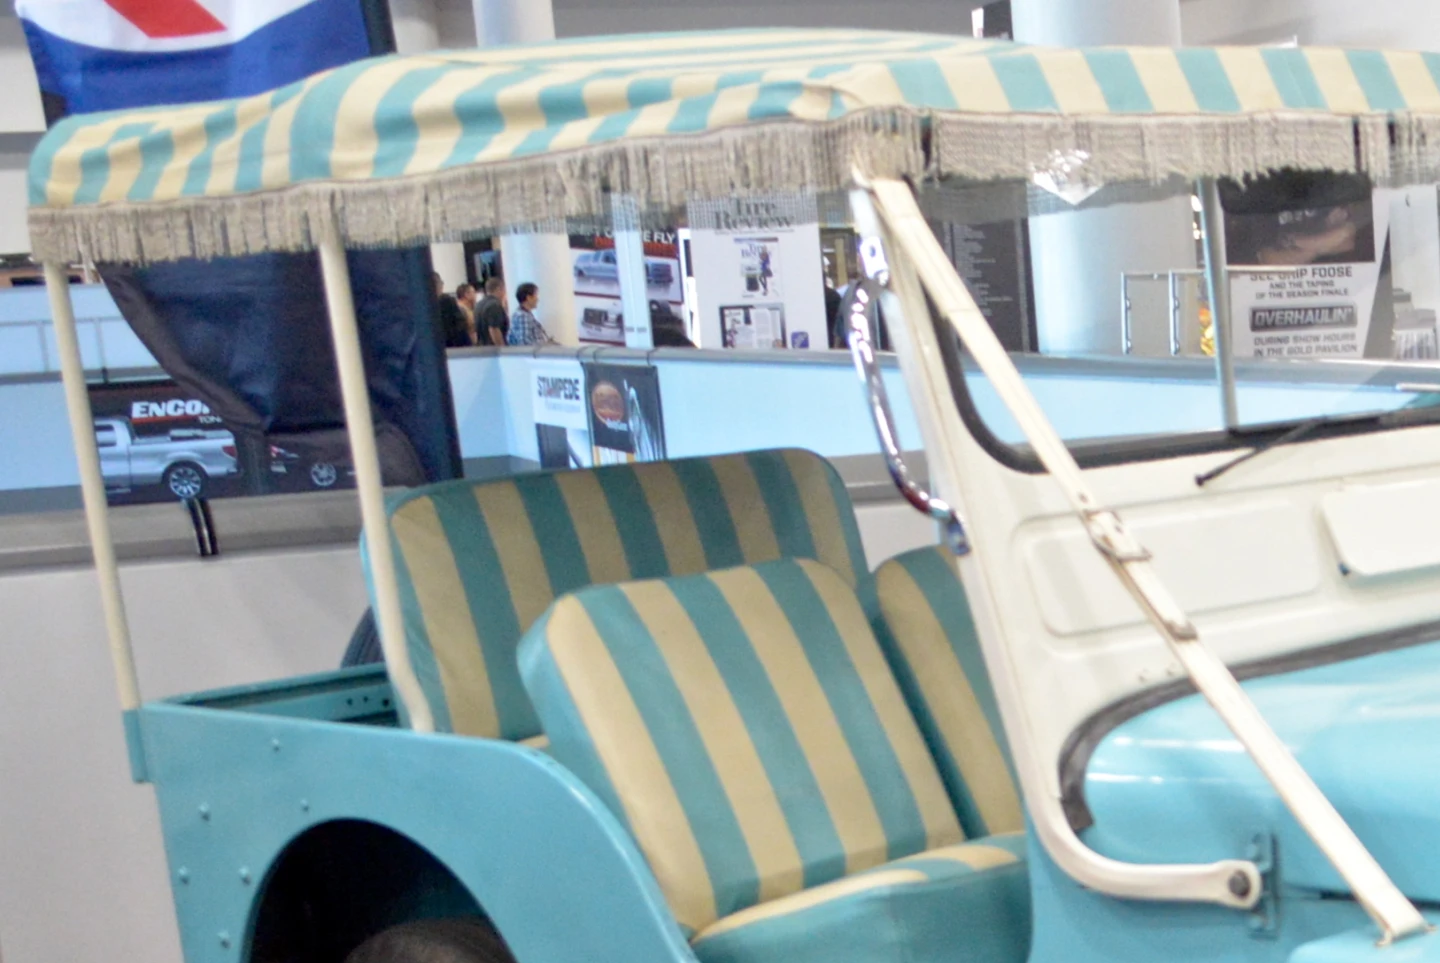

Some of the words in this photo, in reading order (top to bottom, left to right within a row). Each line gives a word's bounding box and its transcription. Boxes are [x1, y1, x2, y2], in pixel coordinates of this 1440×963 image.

[654, 232, 676, 245] FLY
[1312, 266, 1353, 278] FOOSE
[1306, 280, 1335, 288] TAPING
[1286, 290, 1318, 298] SEASON
[1321, 288, 1349, 296] FINALE
[1254, 336, 1290, 346] DURING
[1292, 335, 1321, 343] SHOW
[1323, 333, 1356, 342] HOURS
[1254, 348, 1263, 356] IN
[1267, 347, 1284, 355] THE
[1315, 344, 1358, 353] PAVILION
[537, 376, 580, 400] STAMPEDE
